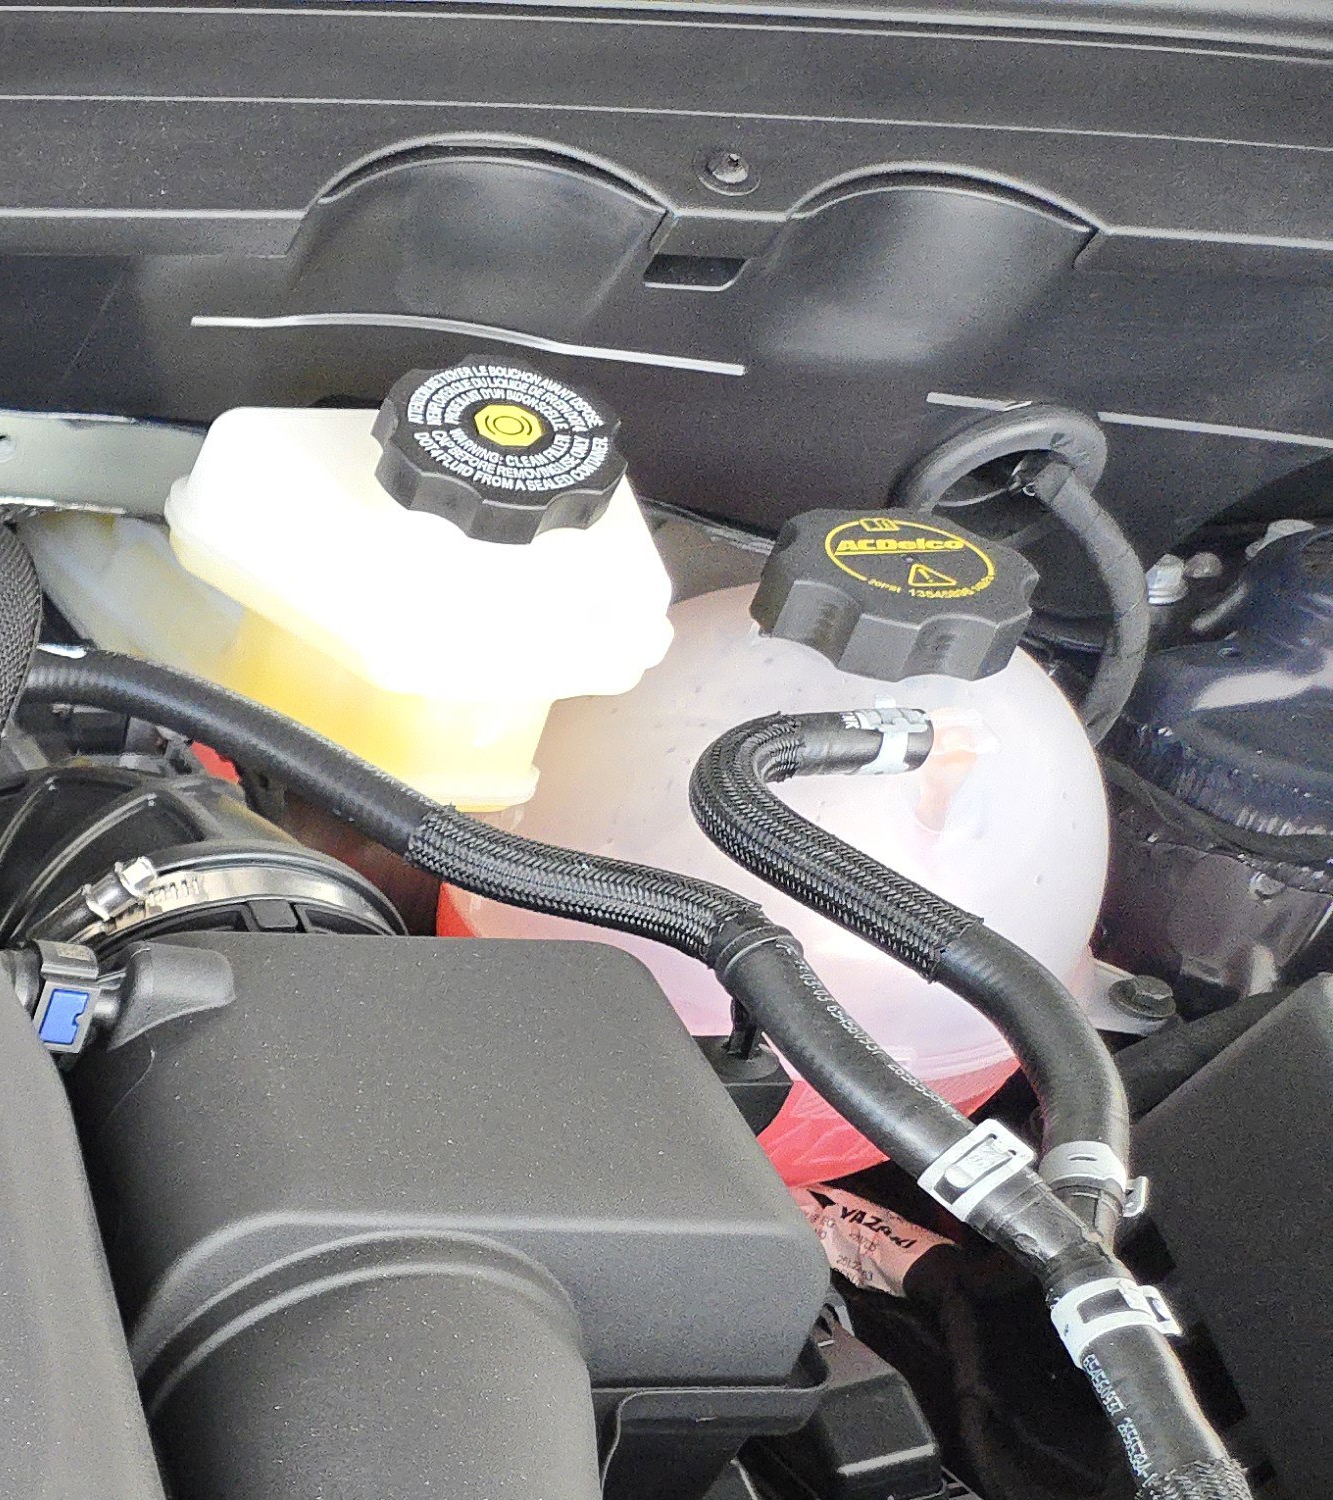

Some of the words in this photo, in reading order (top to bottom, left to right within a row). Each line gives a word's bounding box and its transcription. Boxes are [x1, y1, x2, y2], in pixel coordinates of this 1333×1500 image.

[471, 366, 488, 377] LE
[487, 366, 542, 384] BOUCHON
[471, 377, 487, 388] DU
[486, 377, 530, 392] LIQUIDE
[506, 389, 540, 407] BIDON
[431, 429, 456, 450] CAP
[447, 446, 496, 474] BEFORE
[448, 427, 503, 463] WARNING:
[505, 451, 548, 468] CLEAN
[544, 433, 573, 461] FILLER
[435, 454, 474, 478] FLUID
[472, 471, 514, 490] FROM
[514, 479, 526, 491] A
[525, 473, 575, 491] SEALED
[568, 436, 609, 482] CONTAINER
[836, 538, 966, 552] ACDelco
